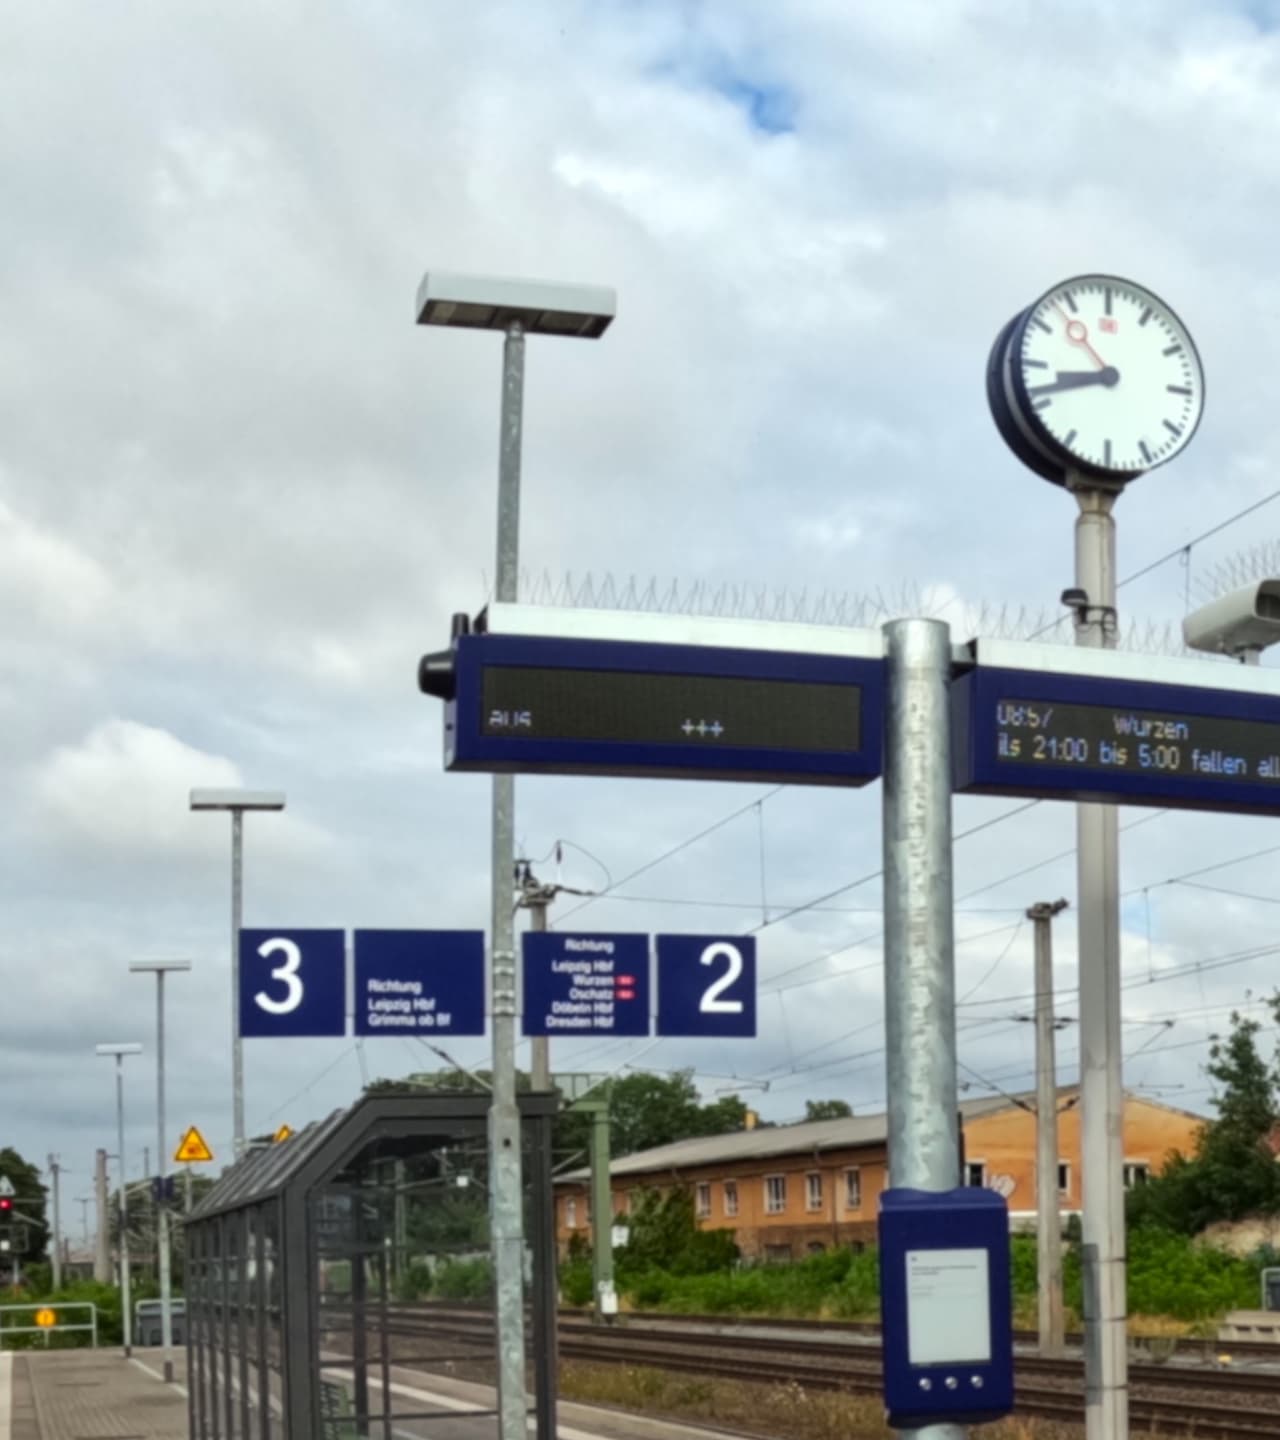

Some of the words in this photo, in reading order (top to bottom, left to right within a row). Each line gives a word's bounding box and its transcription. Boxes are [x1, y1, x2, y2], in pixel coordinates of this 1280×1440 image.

[1113, 714, 1189, 740] Wurzen
[1033, 735, 1088, 763] 21:00
[1099, 740, 1127, 766] bis
[1138, 744, 1180, 771] 5:00
[1192, 749, 1247, 775] fallen
[565, 939, 614, 953] Richtung
[552, 960, 591, 973] Leipzig
[594, 960, 614, 972] Hbf
[255, 938, 303, 1014] 3
[573, 974, 614, 986] Wurzen
[700, 942, 742, 1012] 2
[368, 979, 422, 995] Richtung
[569, 988, 613, 1000] Oschatz
[368, 998, 411, 1013] Leipzig
[414, 998, 436, 1011] Hbf
[593, 1002, 614, 1014] Hbf
[368, 1013, 416, 1026] Grimma
[546, 1015, 591, 1028] Dresden
[593, 1015, 614, 1028] Hbf
